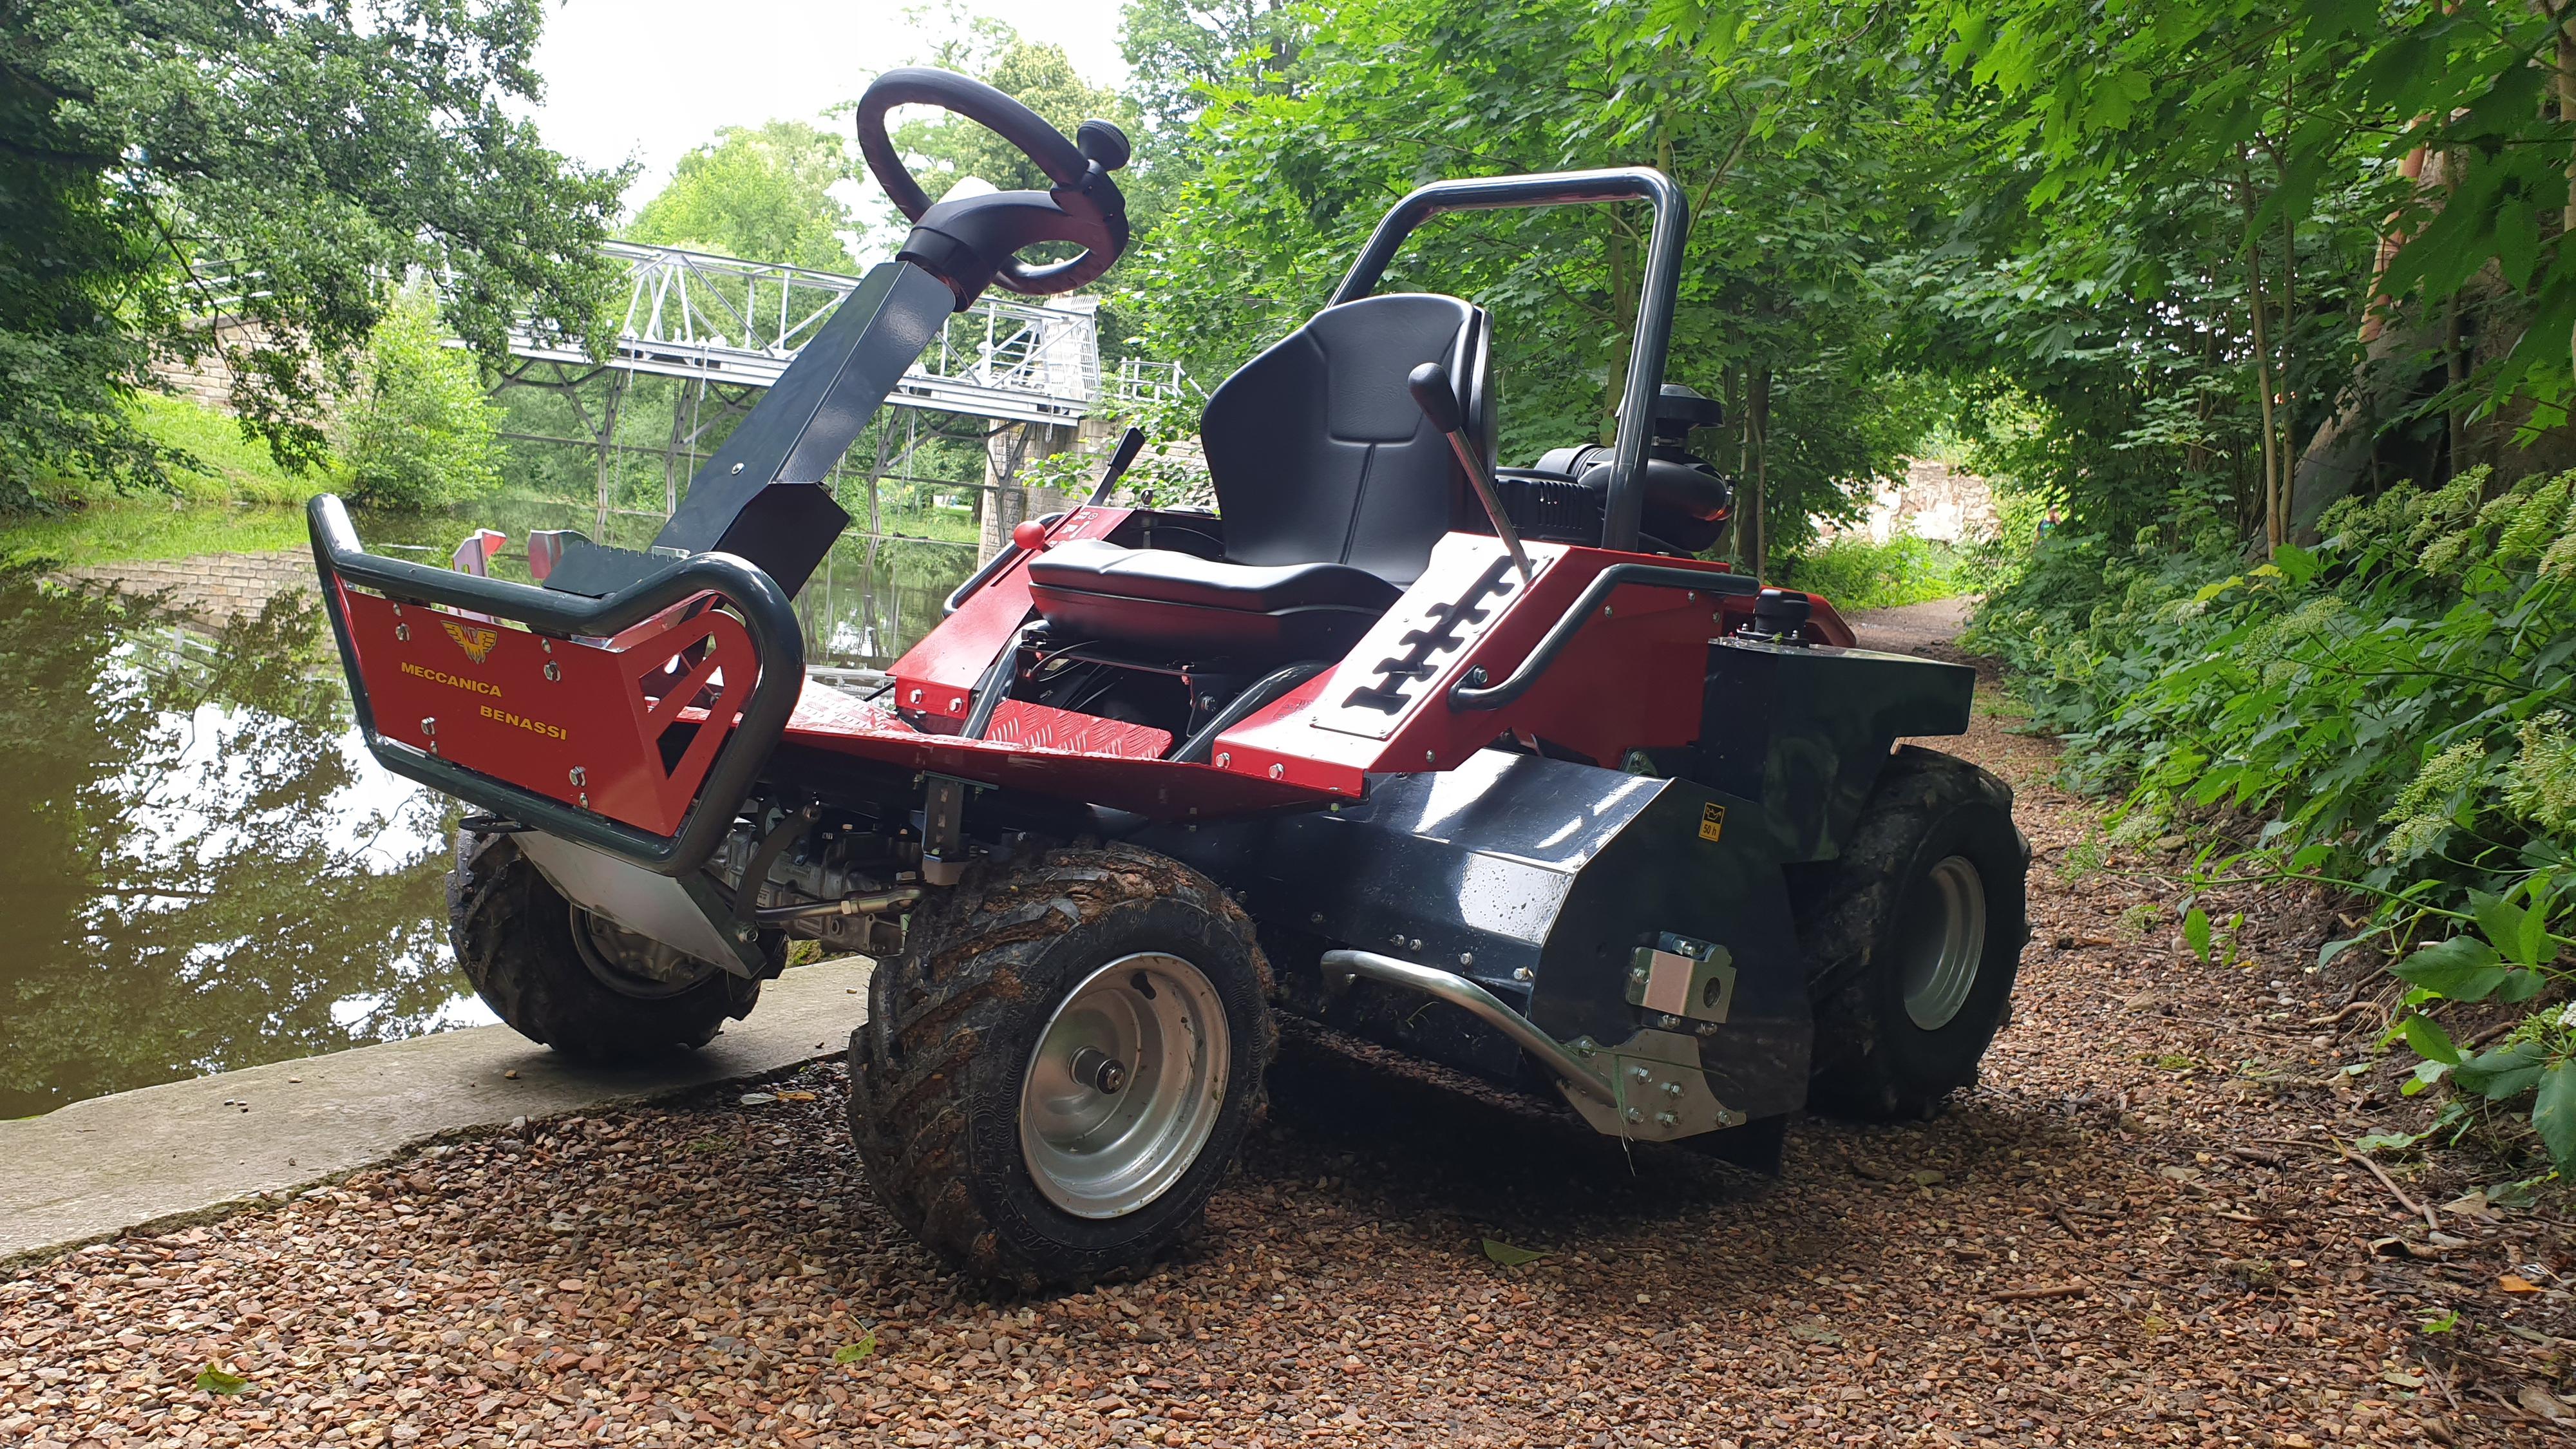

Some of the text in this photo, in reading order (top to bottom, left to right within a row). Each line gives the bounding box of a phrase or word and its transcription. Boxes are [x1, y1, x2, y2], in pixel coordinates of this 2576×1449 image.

[401, 661, 502, 697] MECCANICA
[480, 705, 567, 741] BENASSI
[1703, 824, 1716, 836] 50 h
